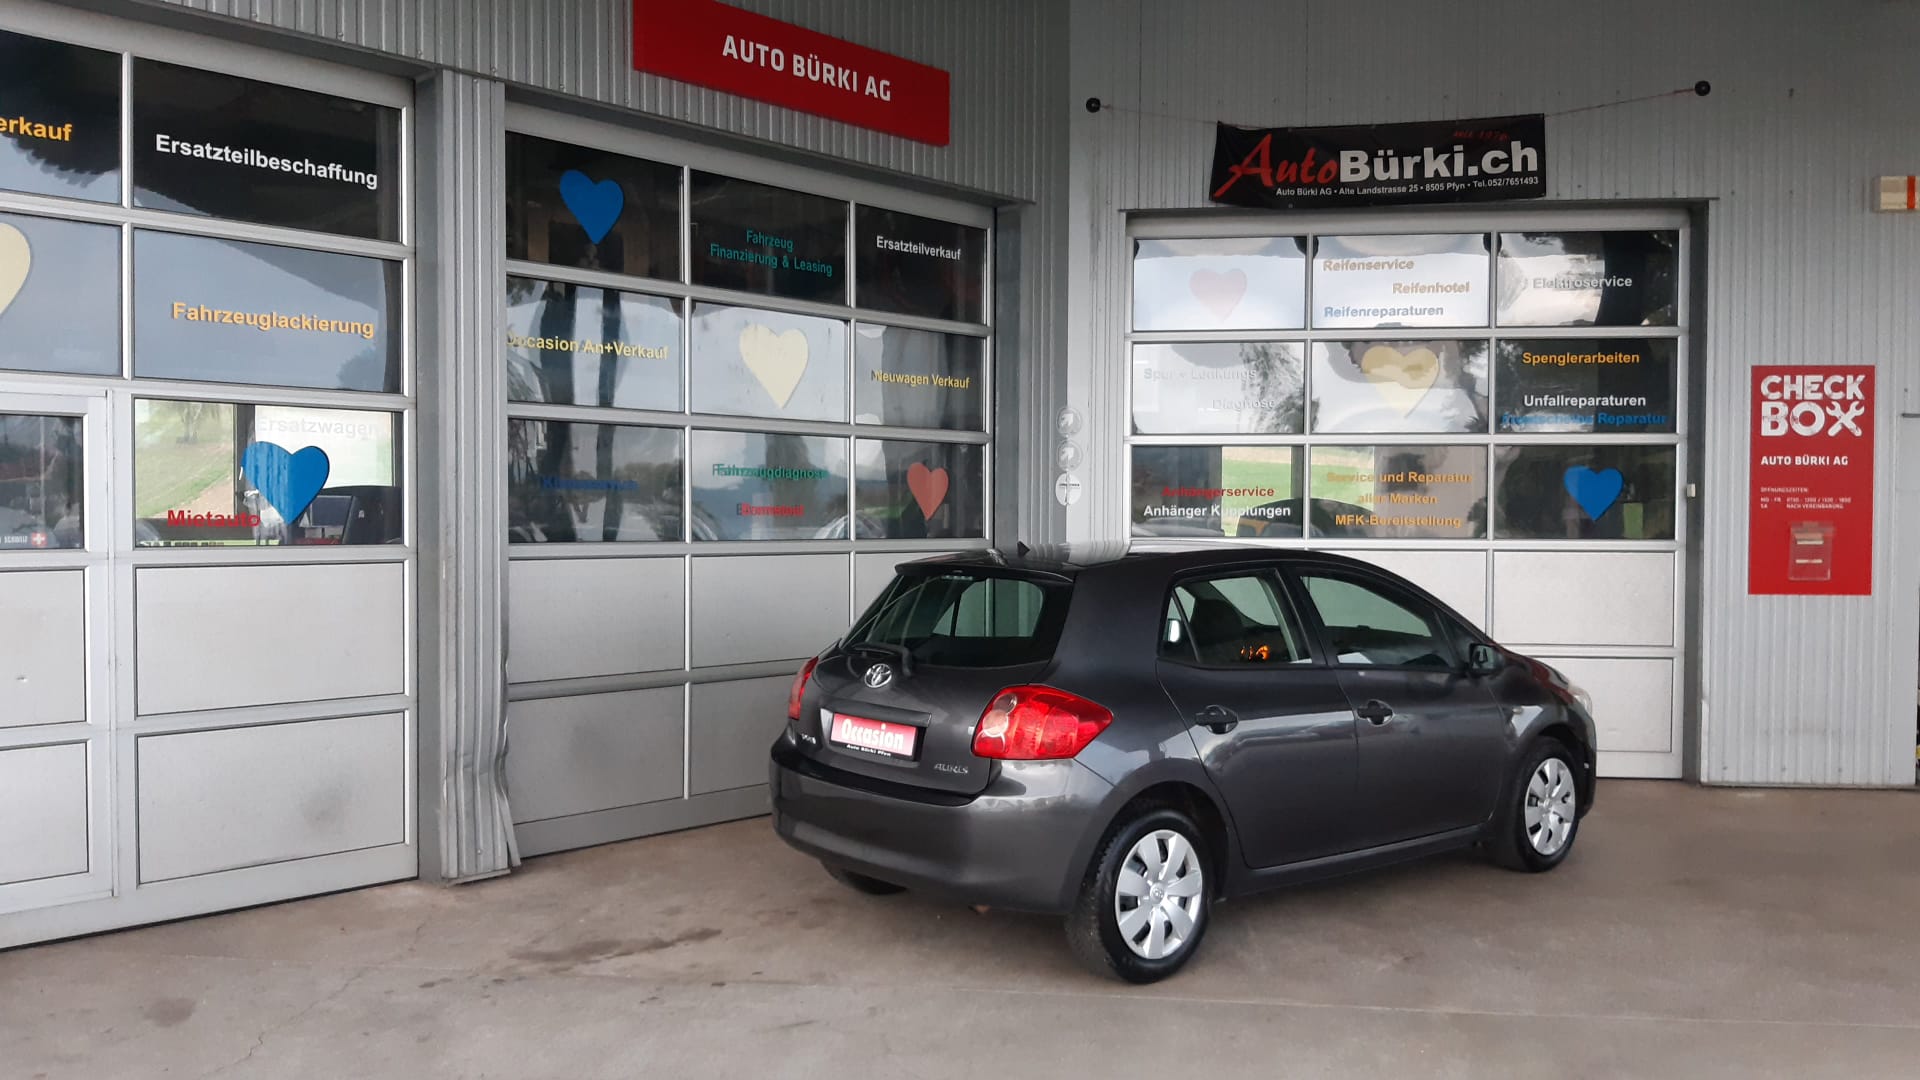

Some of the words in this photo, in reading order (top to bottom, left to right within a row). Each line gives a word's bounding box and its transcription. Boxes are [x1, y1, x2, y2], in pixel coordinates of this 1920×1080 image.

[722, 35, 784, 71] AUTO
[793, 54, 857, 92] BÜRKI
[865, 76, 892, 101] AG
[155, 133, 378, 190] Ersatzteilbeschaffung
[1276, 187, 1295, 196] Auto
[1297, 186, 1318, 196] Bürki
[1320, 187, 1333, 196] AG
[1339, 186, 1355, 195] Alte
[1357, 184, 1407, 195] Landstrasse
[1409, 183, 1419, 193] 25
[1426, 182, 1445, 192] 8505
[1447, 181, 1466, 193] Pfyn
[746, 229, 794, 253] Fahrzeug
[876, 235, 962, 261] Ersatzteilverkauf
[710, 243, 778, 269] Finanzierung
[782, 255, 790, 268] &
[793, 256, 833, 277] Leasing
[1322, 258, 1415, 272] Reifenservice
[1392, 281, 1471, 295] Reifenhotel
[1532, 275, 1633, 289] Elektroservice
[1324, 305, 1444, 319] Reifenreparaturen
[172, 302, 375, 340] Fahrzeuglackierung
[583, 337, 669, 361] An+Verkauf
[1522, 351, 1640, 368] Spenglerarbeiten
[872, 369, 929, 388] Neuwagen
[931, 373, 971, 390] Verkauf
[1761, 374, 1866, 400] CHECK
[1524, 394, 1646, 409] Unfallreparaturen
[1597, 412, 1667, 427] Reparatur
[1761, 400, 1866, 437] BOX
[1761, 456, 1792, 466] AUTO
[1795, 454, 1830, 466] BÜRKI
[1833, 456, 1849, 466] AG
[1379, 471, 1405, 484] und
[1162, 485, 1275, 500] Anhängerservice
[1389, 493, 1438, 505] Marken
[167, 509, 262, 529] Mietauto
[1143, 503, 1208, 519] Anhänger
[1335, 514, 1463, 529] MFK-Bereitstellung
[841, 718, 905, 751] Occasion
